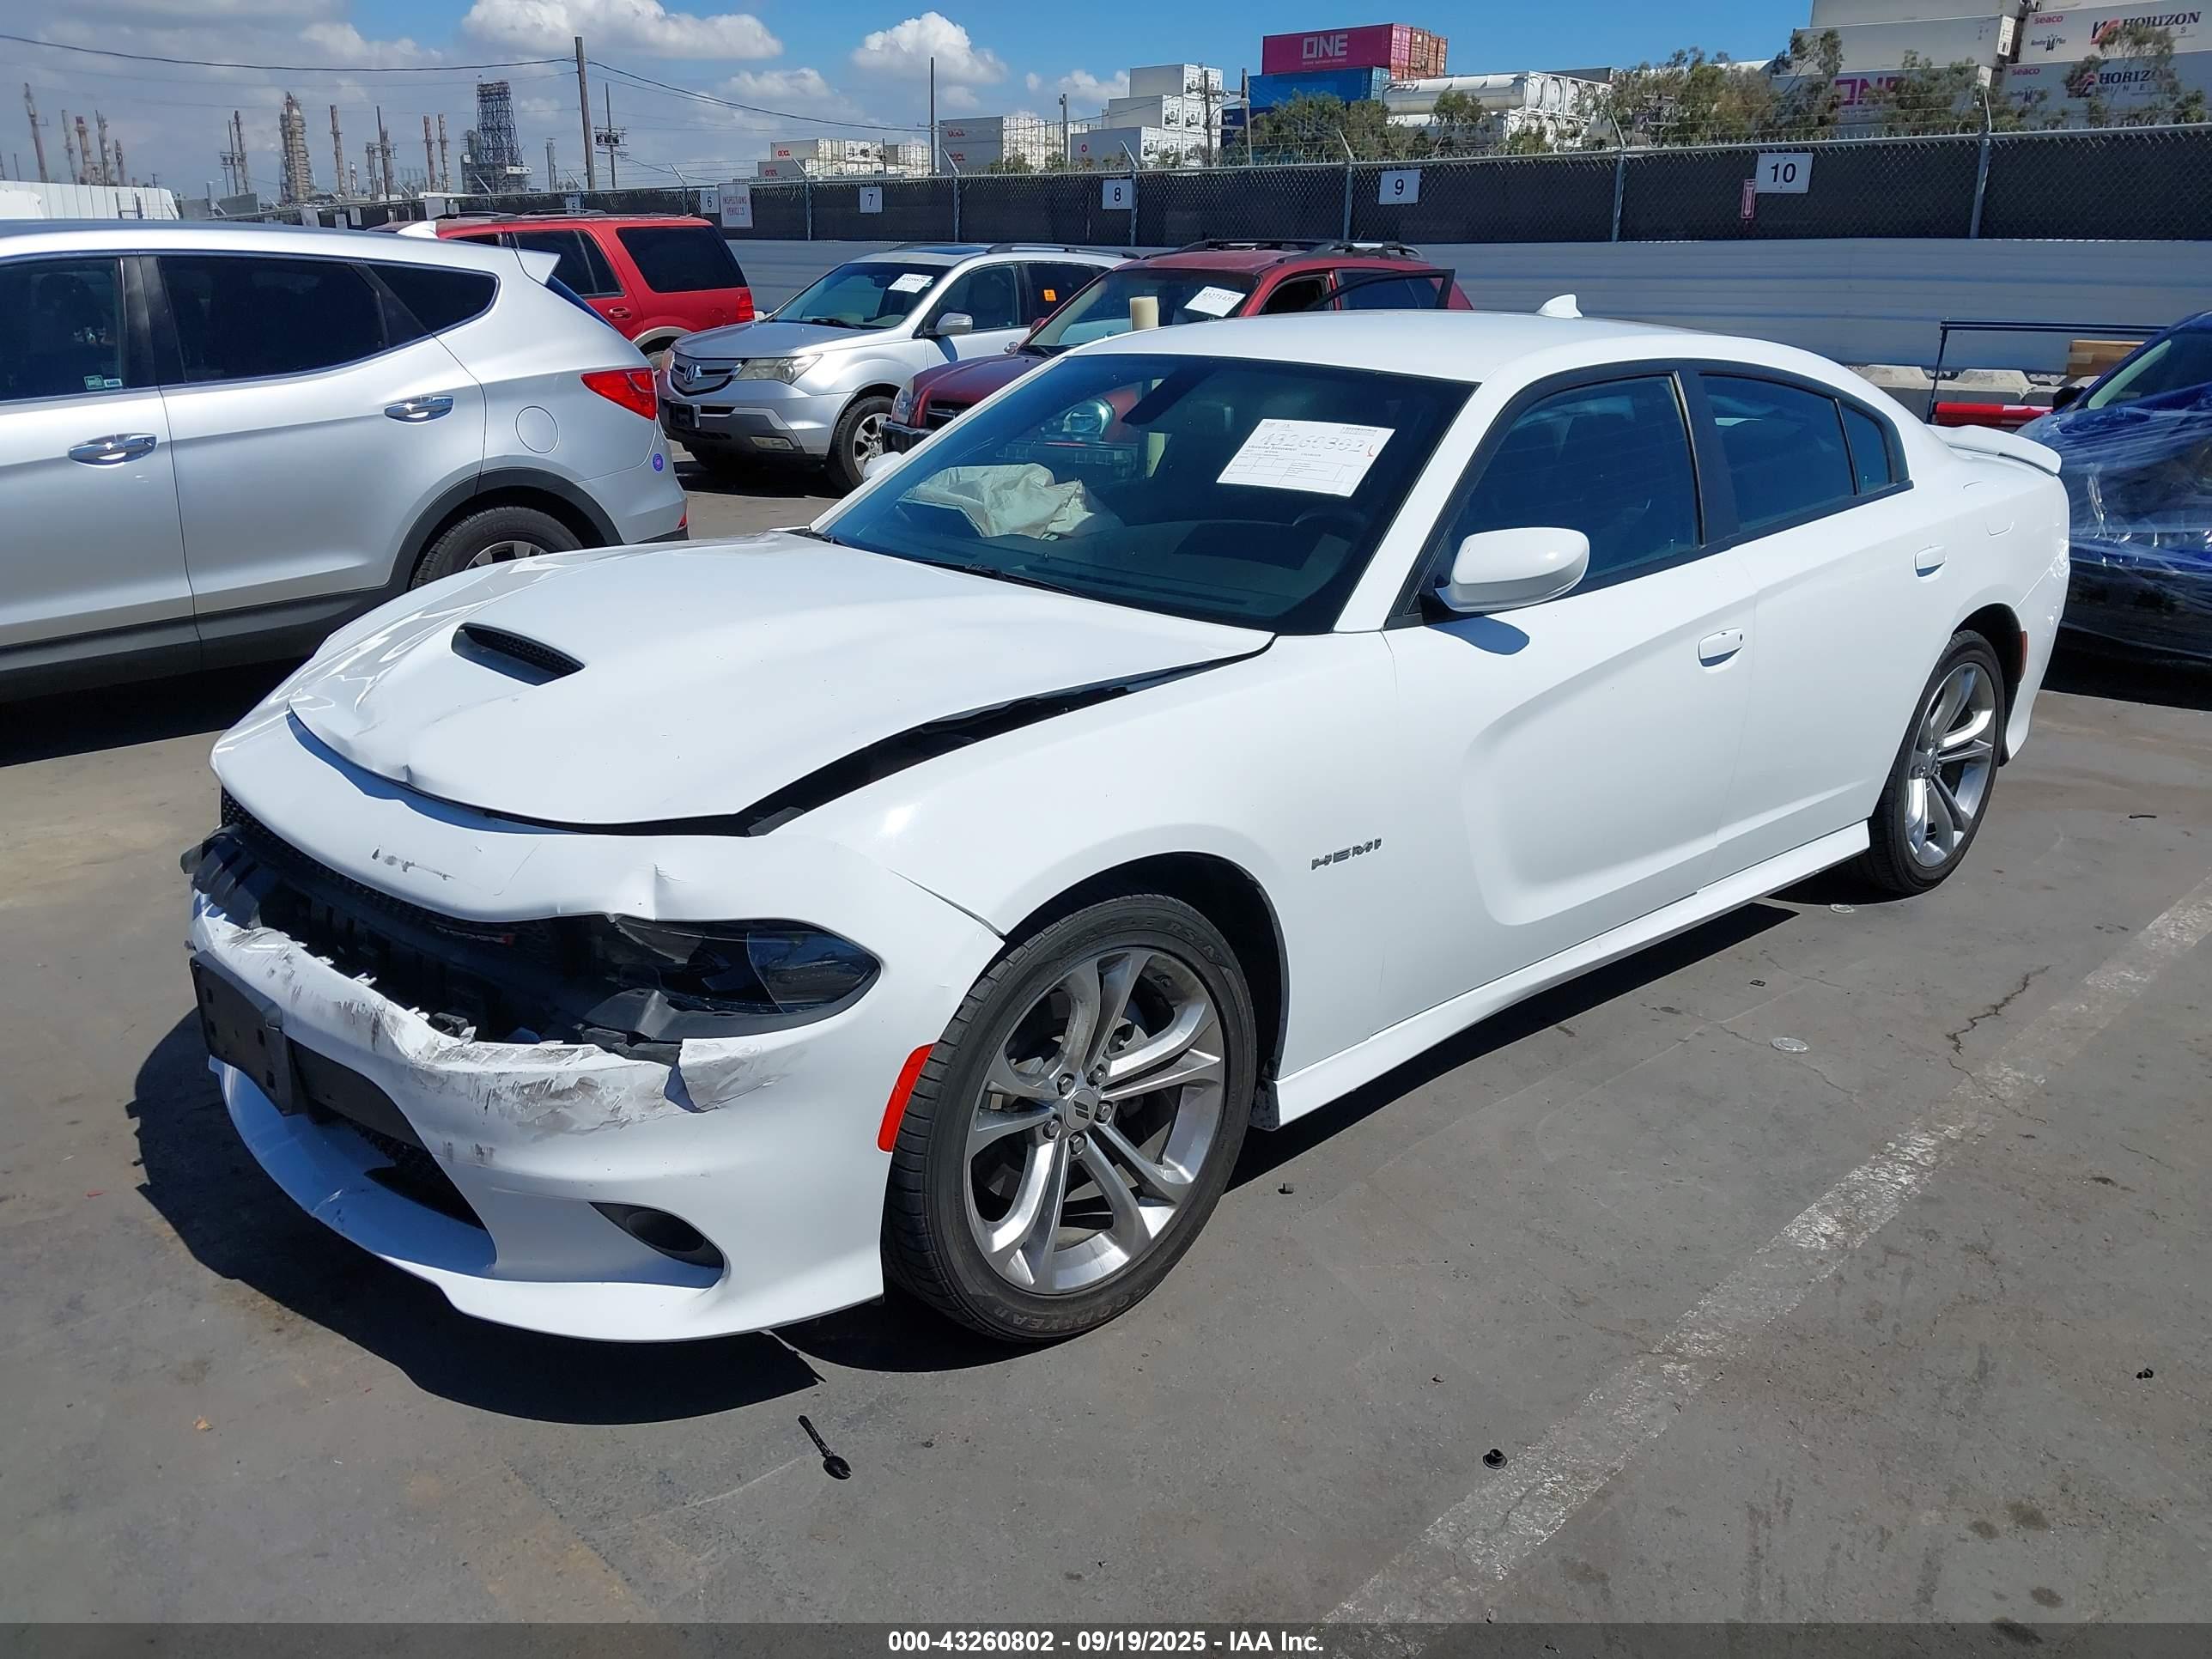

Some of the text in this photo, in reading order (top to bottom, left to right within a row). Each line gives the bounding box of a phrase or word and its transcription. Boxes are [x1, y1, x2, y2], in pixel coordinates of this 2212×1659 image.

[2033, 14, 2063, 24] seaco
[1302, 33, 1348, 59] ONE
[2011, 67, 2040, 76] seaco
[1771, 162, 1796, 184] 10
[1114, 187, 1121, 202] 8
[1395, 179, 1405, 196] 9
[707, 198, 713, 208] 6
[867, 194, 874, 207] 7
[1311, 838, 1382, 871] HEMI
